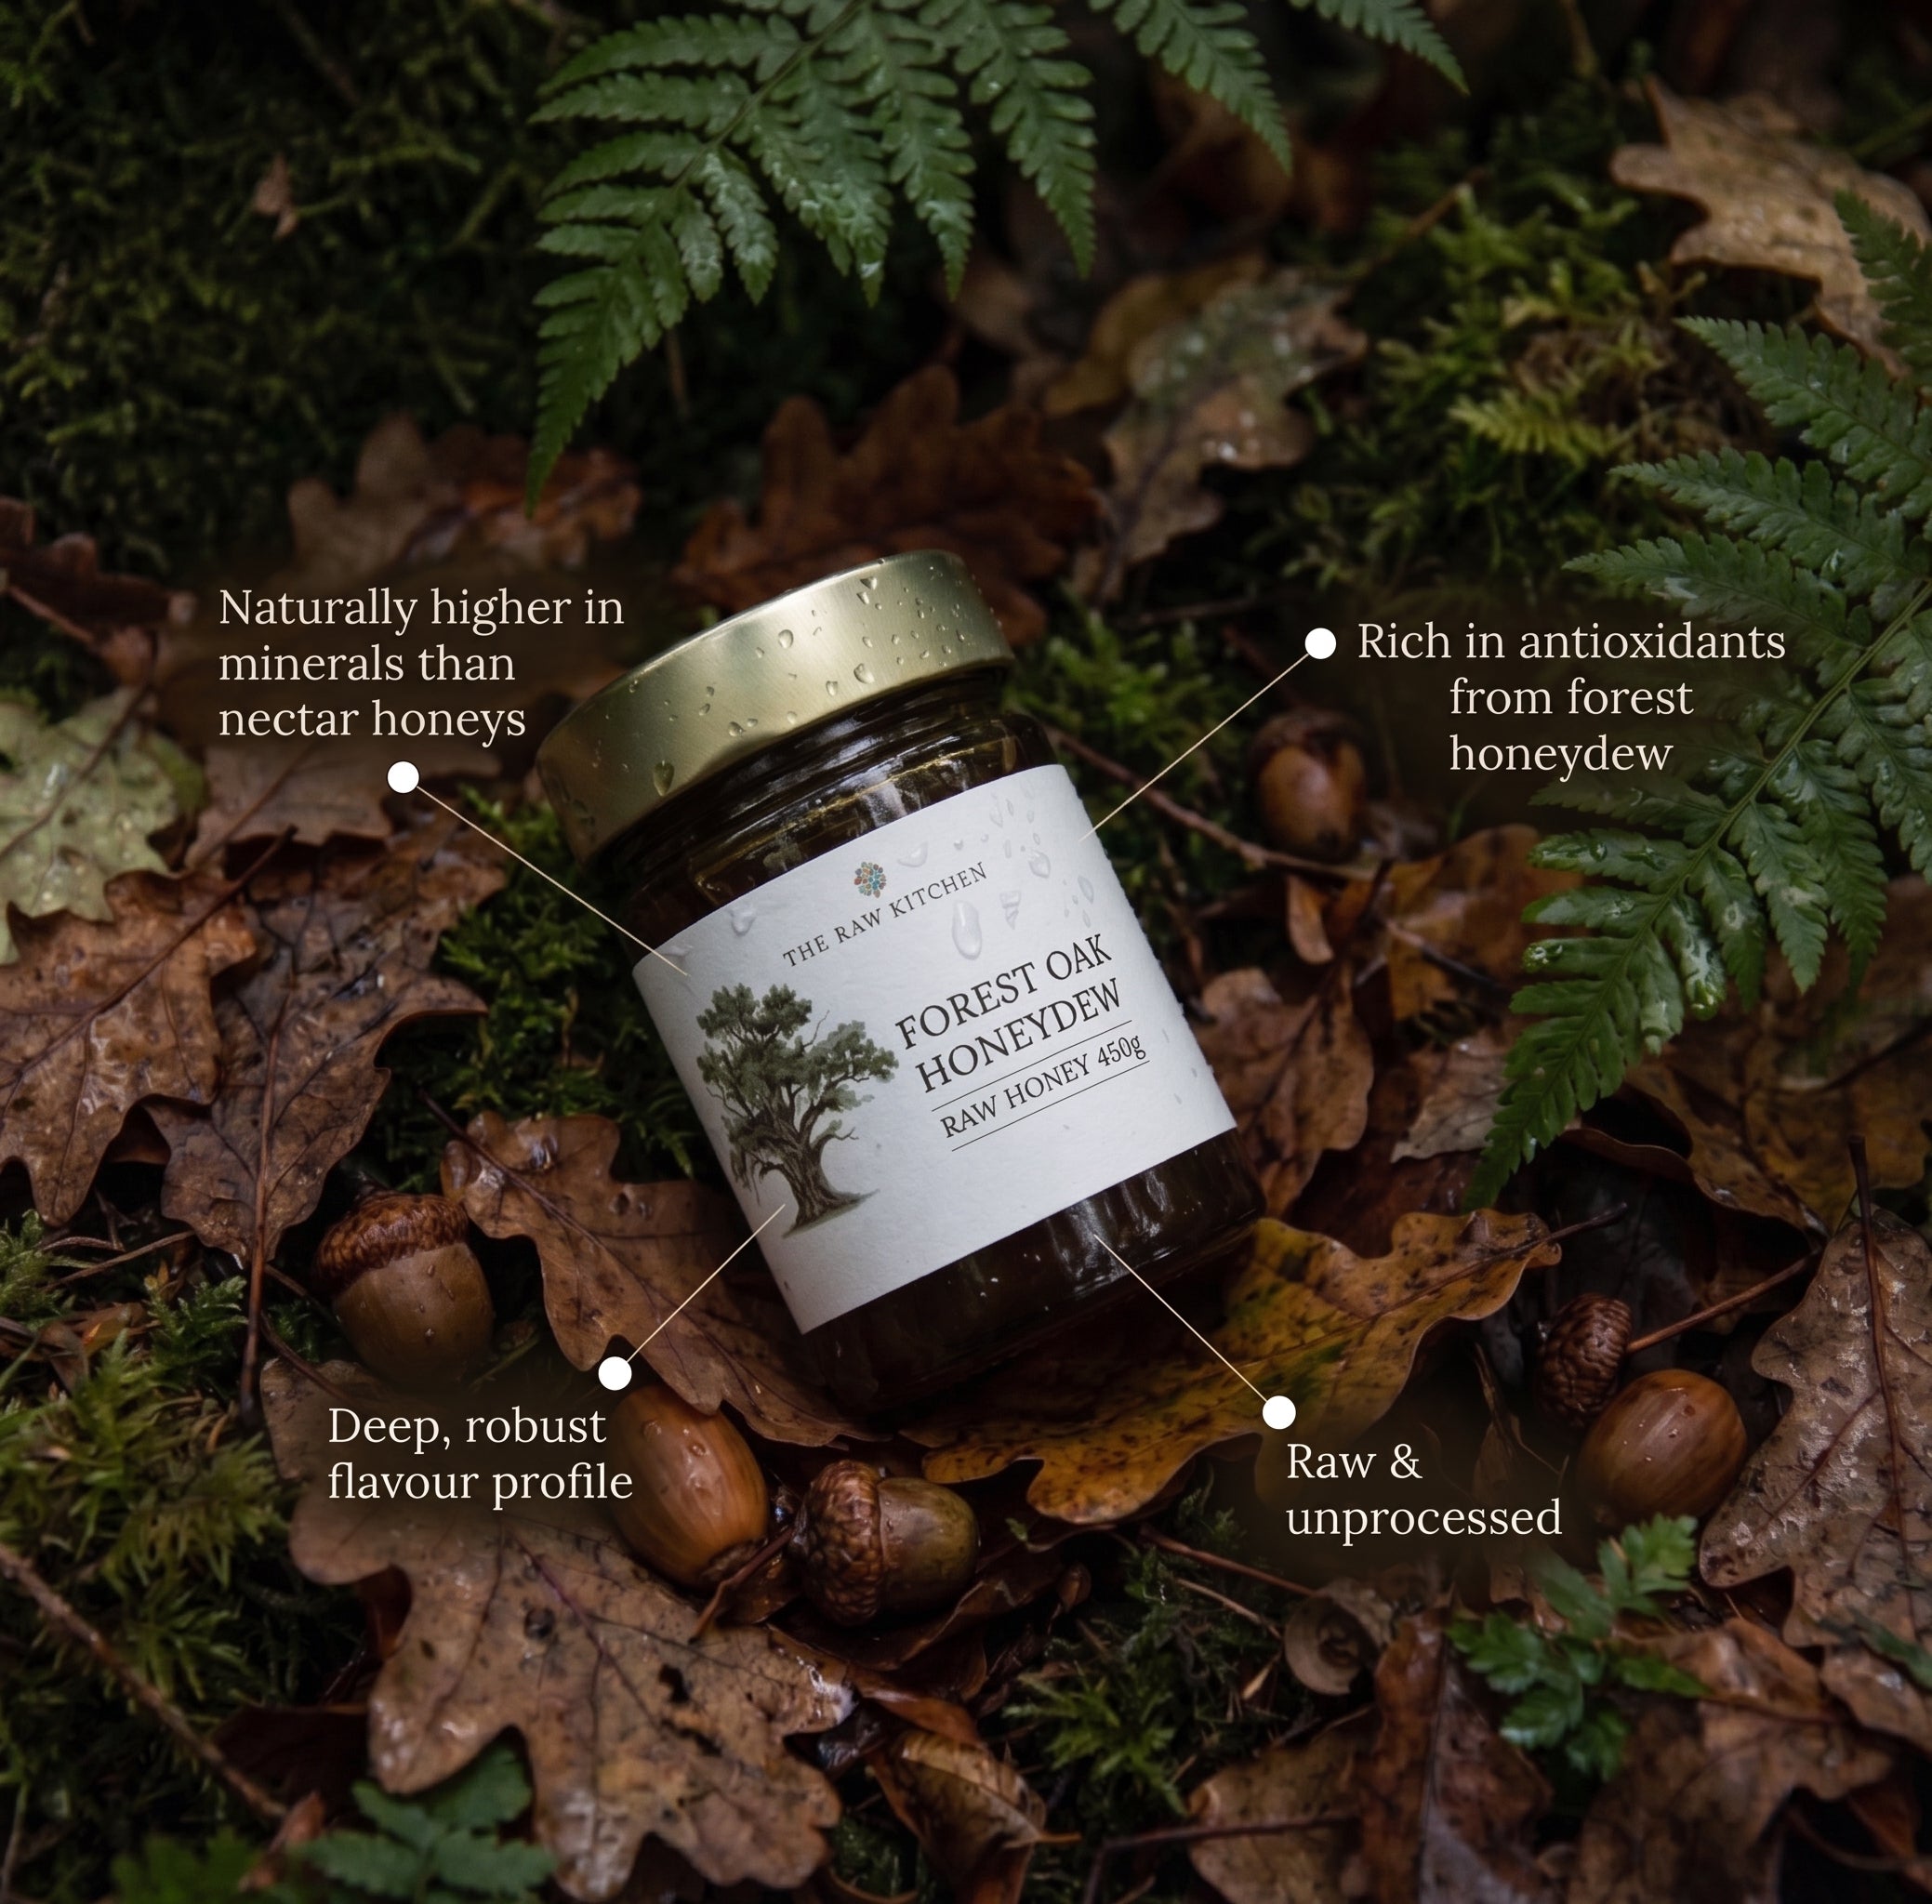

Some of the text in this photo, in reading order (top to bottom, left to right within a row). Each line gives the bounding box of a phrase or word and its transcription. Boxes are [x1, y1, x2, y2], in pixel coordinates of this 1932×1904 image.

[783, 861, 987, 968] THE RAW KITCHEN
[894, 932, 1113, 1051] FOREST OAK
[914, 977, 1121, 1094] HONEYDEW
[939, 1034, 1148, 1139] RAW HONEY 450g
